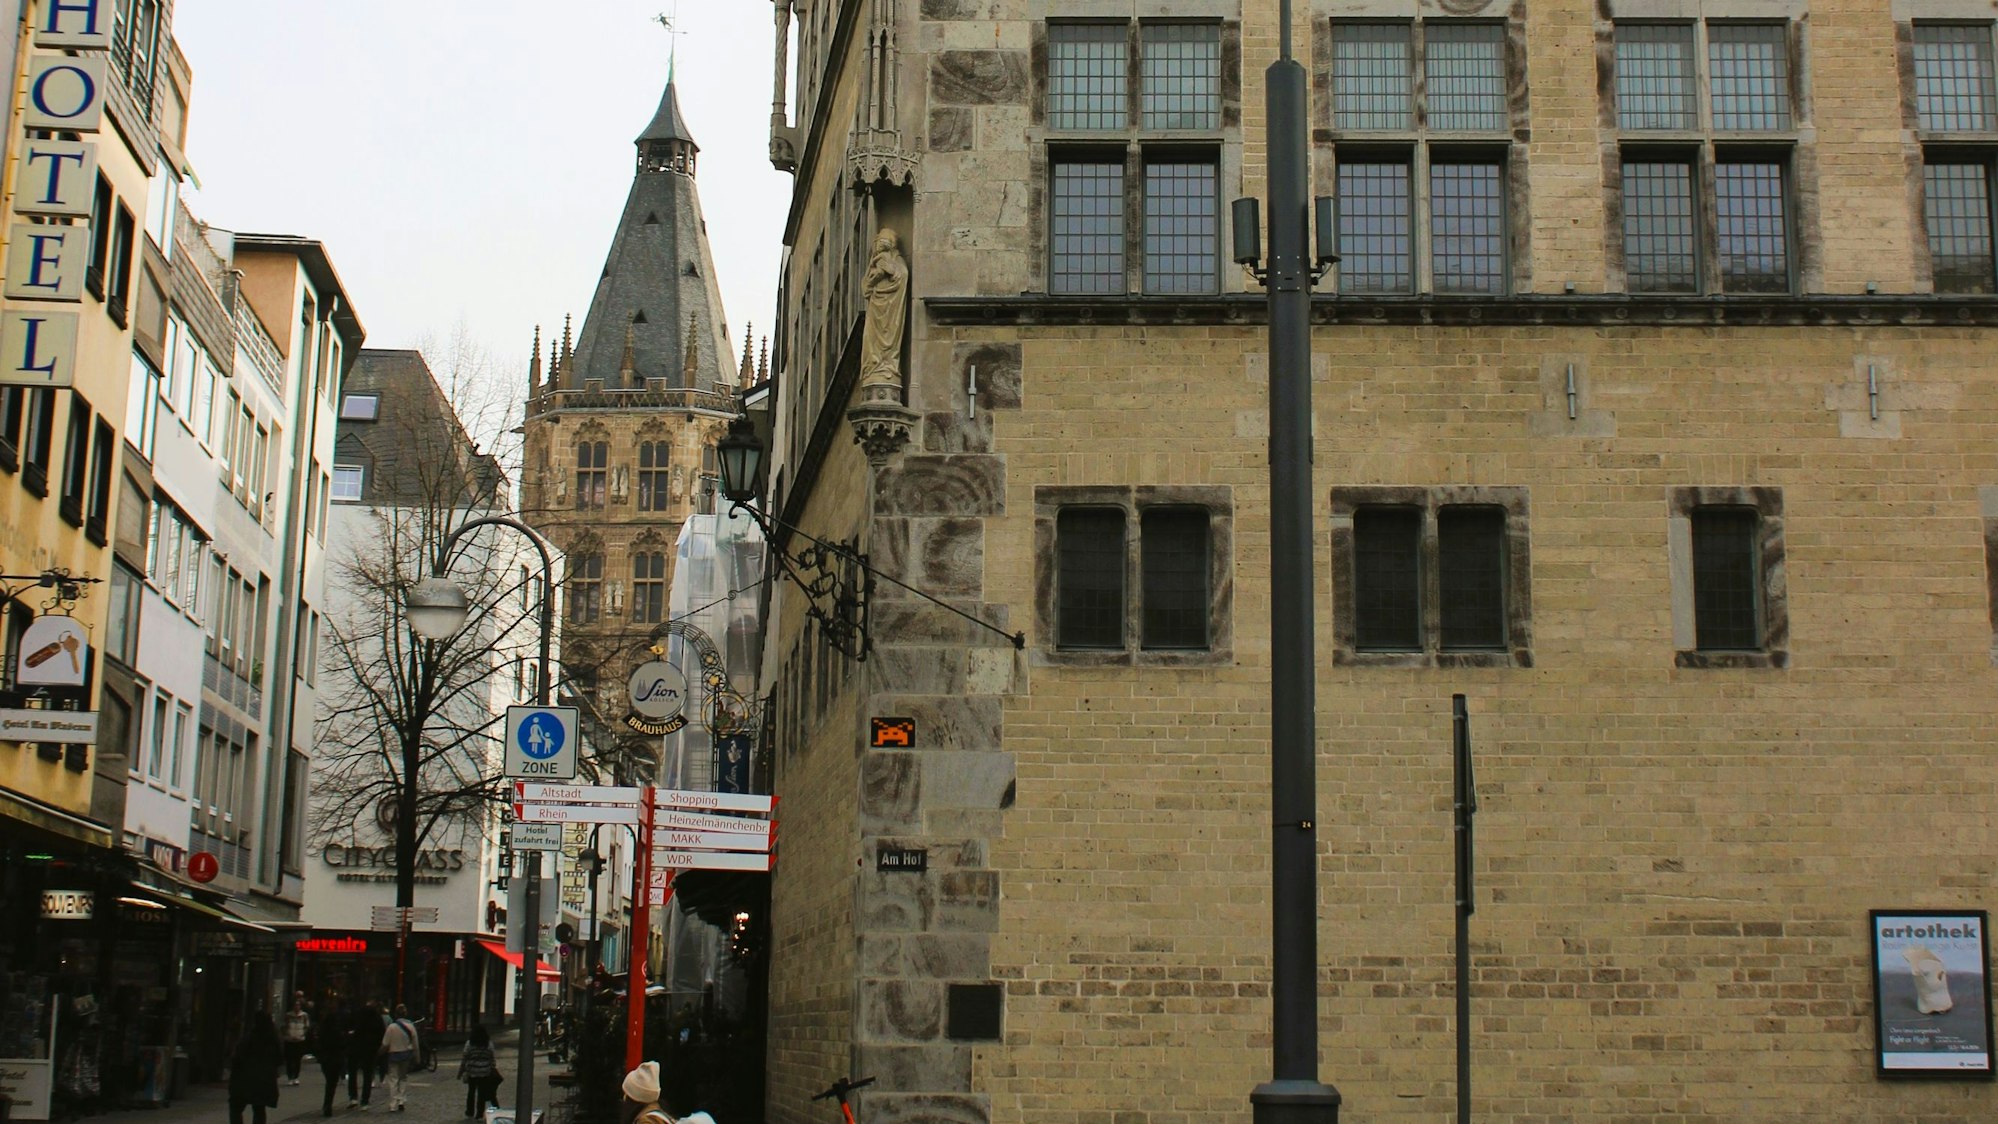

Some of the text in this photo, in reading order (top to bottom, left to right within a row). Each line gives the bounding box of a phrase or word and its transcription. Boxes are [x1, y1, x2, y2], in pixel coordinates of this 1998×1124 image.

[16, 0, 103, 380] HOTEL
[635, 678, 679, 701] Sion
[628, 717, 682, 735] BRAUHAUS
[521, 761, 558, 774] ZONE
[541, 787, 582, 799] Altstadt
[670, 793, 718, 807] Shopping
[539, 808, 568, 819] Rhein
[526, 826, 548, 834] Hotel
[669, 814, 768, 833] Heinzelmännchenbr.
[514, 836, 559, 845] zufahrt frei
[671, 833, 702, 844] MAKK
[323, 843, 463, 871] CITYCASS
[667, 854, 693, 865] WDR
[881, 852, 899, 865] Am
[1881, 923, 1977, 938] artothek
[296, 936, 368, 951] souvenirs
